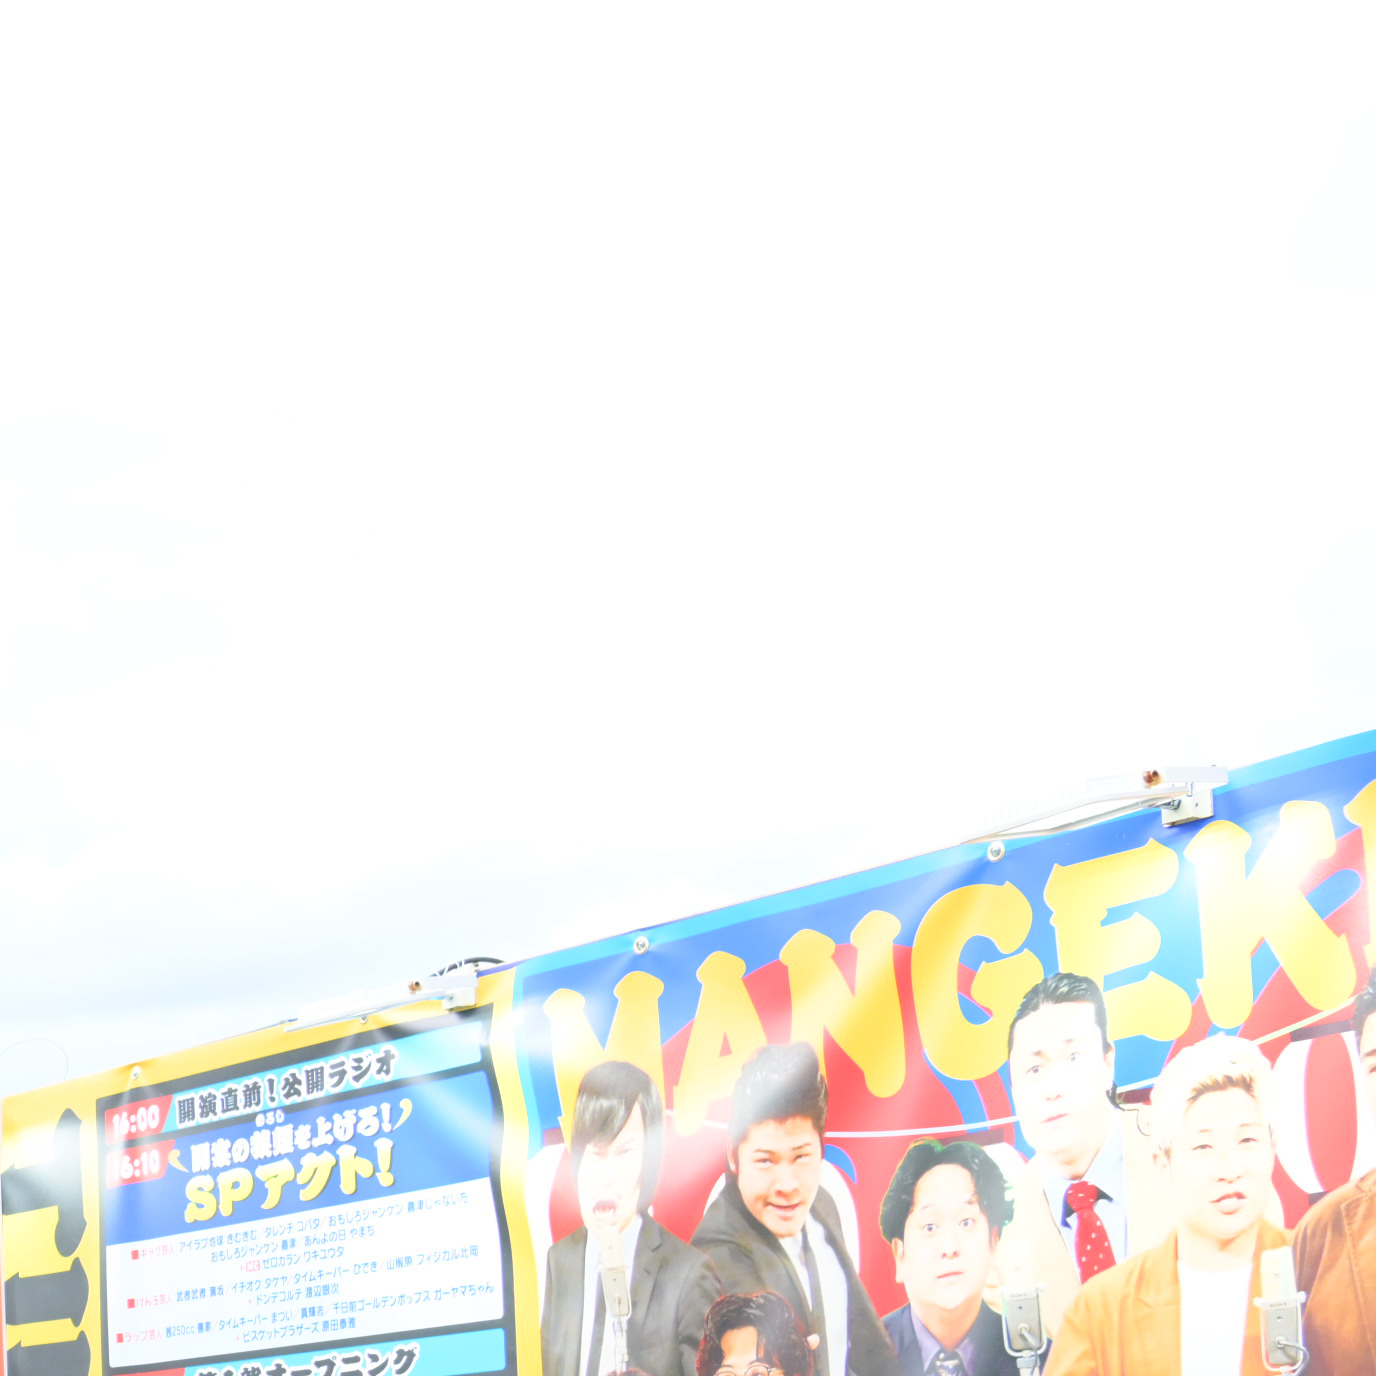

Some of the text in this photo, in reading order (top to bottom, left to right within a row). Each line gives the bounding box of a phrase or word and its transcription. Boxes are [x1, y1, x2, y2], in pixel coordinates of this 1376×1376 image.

[112, 1104, 160, 1136] 16:00
[112, 1150, 160, 1180] 16:10
[185, 1138, 395, 1223] SPアクト!
